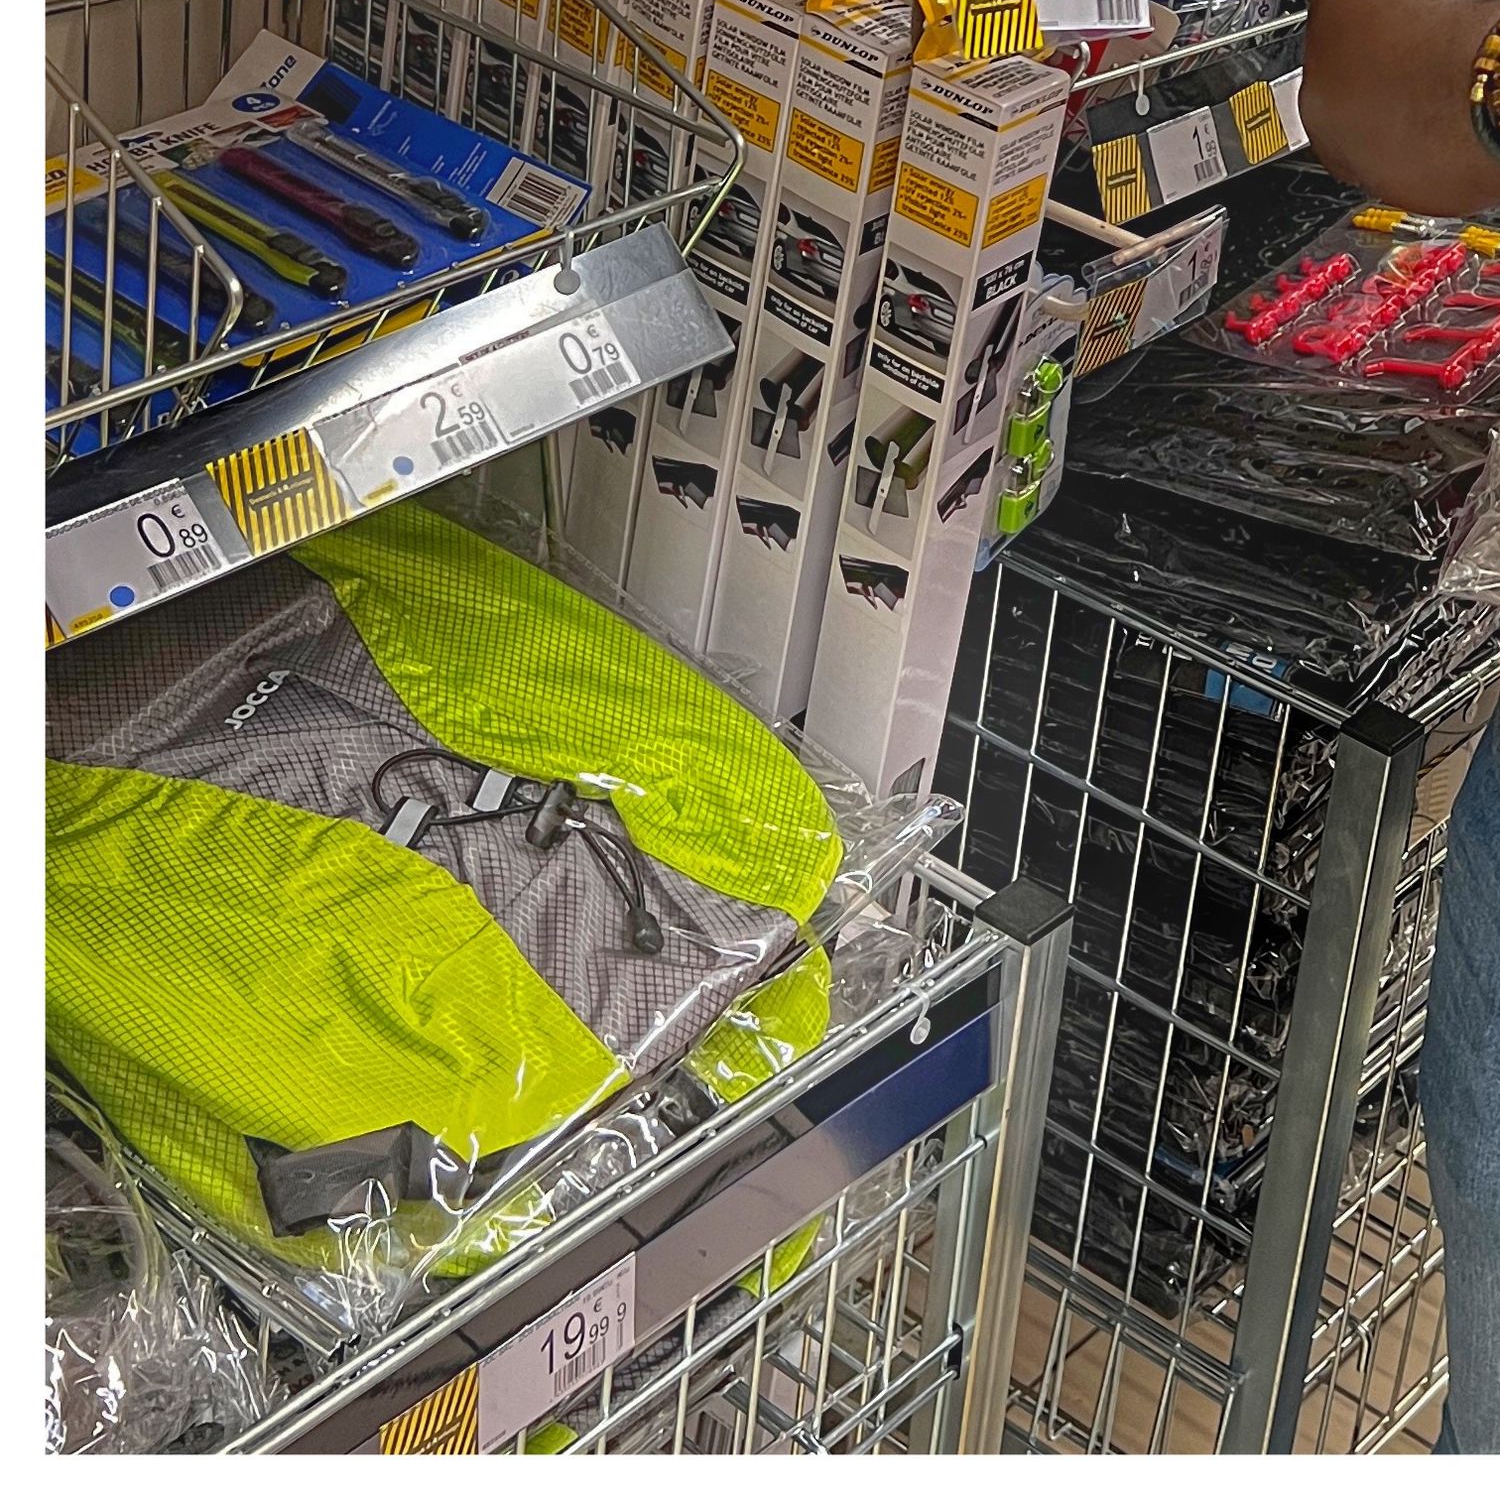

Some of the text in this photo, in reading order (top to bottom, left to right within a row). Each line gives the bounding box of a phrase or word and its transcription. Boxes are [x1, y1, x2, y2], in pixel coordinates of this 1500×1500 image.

[820, 31, 880, 63] DUNLOP
[800, 55, 822, 73] SOLAR
[852, 81, 871, 97] FILM
[931, 84, 995, 117] DUNLOP
[161, 121, 221, 148] KNIFE
[909, 108, 934, 127] SOLAR
[966, 133, 986, 149] FILM
[1191, 125, 1205, 162] 1
[1187, 249, 1199, 282] 1
[984, 272, 1018, 301] BLACK
[557, 323, 621, 376] 0 € 79
[876, 350, 892, 365] only
[891, 358, 902, 370] for
[420, 384, 486, 438] 2 € 59
[136, 503, 209, 559] 0 € 89
[223, 669, 292, 731] JOCCA
[540, 1296, 610, 1376] 19 € 99
